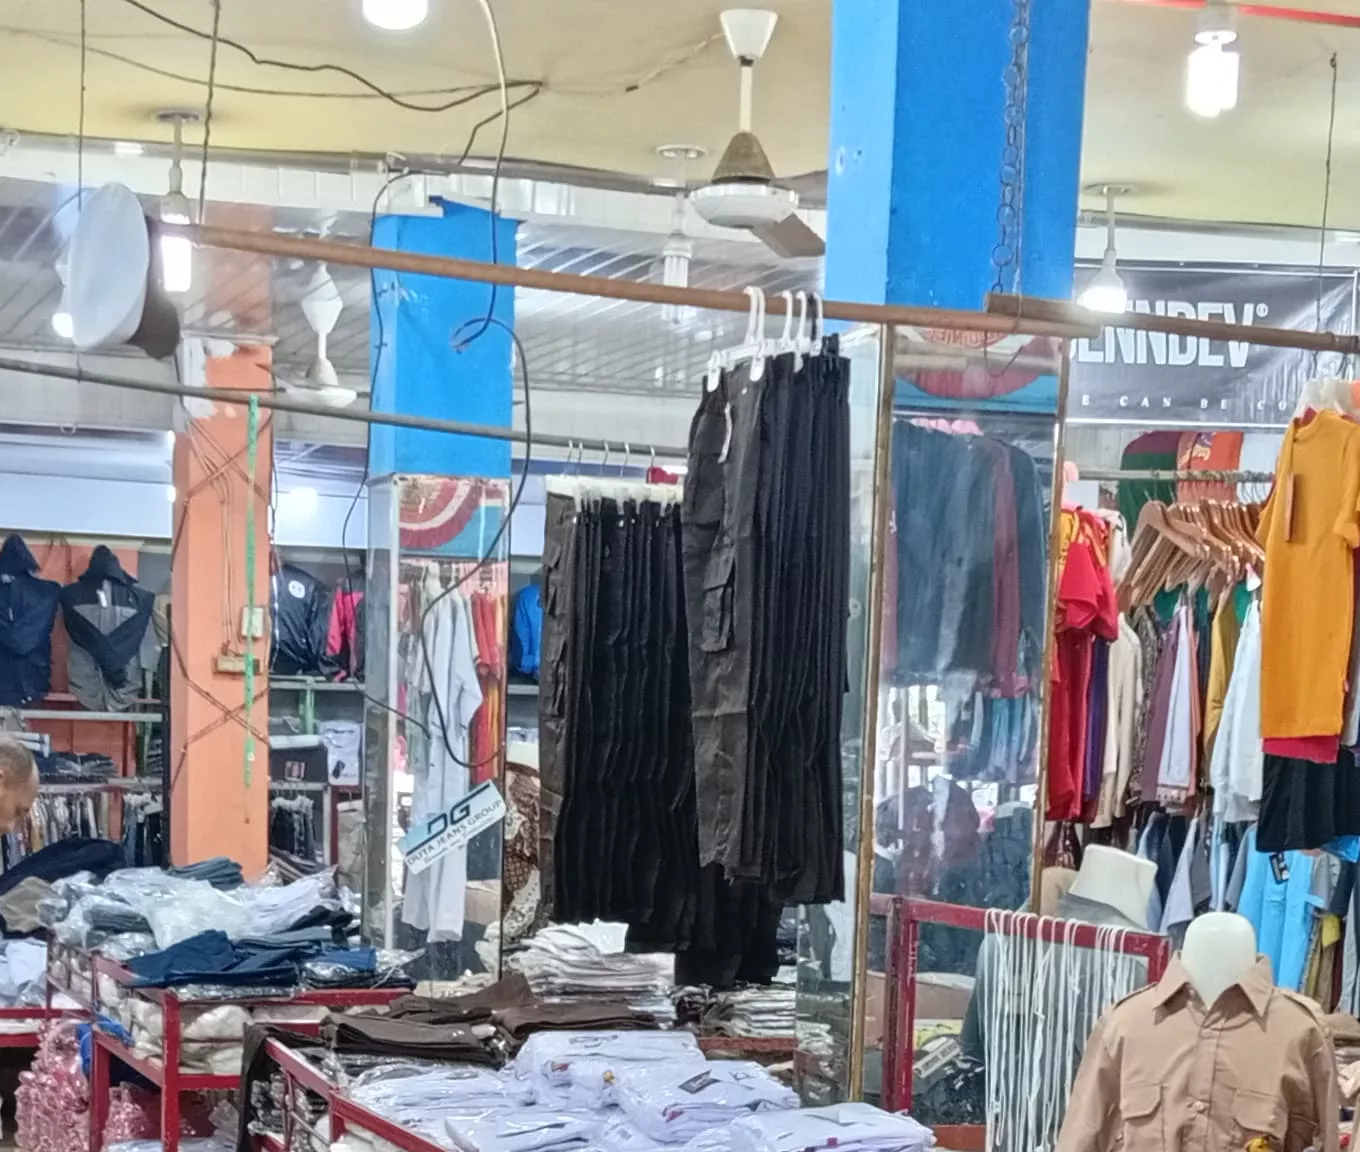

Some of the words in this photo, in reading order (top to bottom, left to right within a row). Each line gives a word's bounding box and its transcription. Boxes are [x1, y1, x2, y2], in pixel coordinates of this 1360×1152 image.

[407, 844, 436, 866] DUTA
[437, 823, 467, 846] JEANS
[467, 799, 502, 826] GROUP
